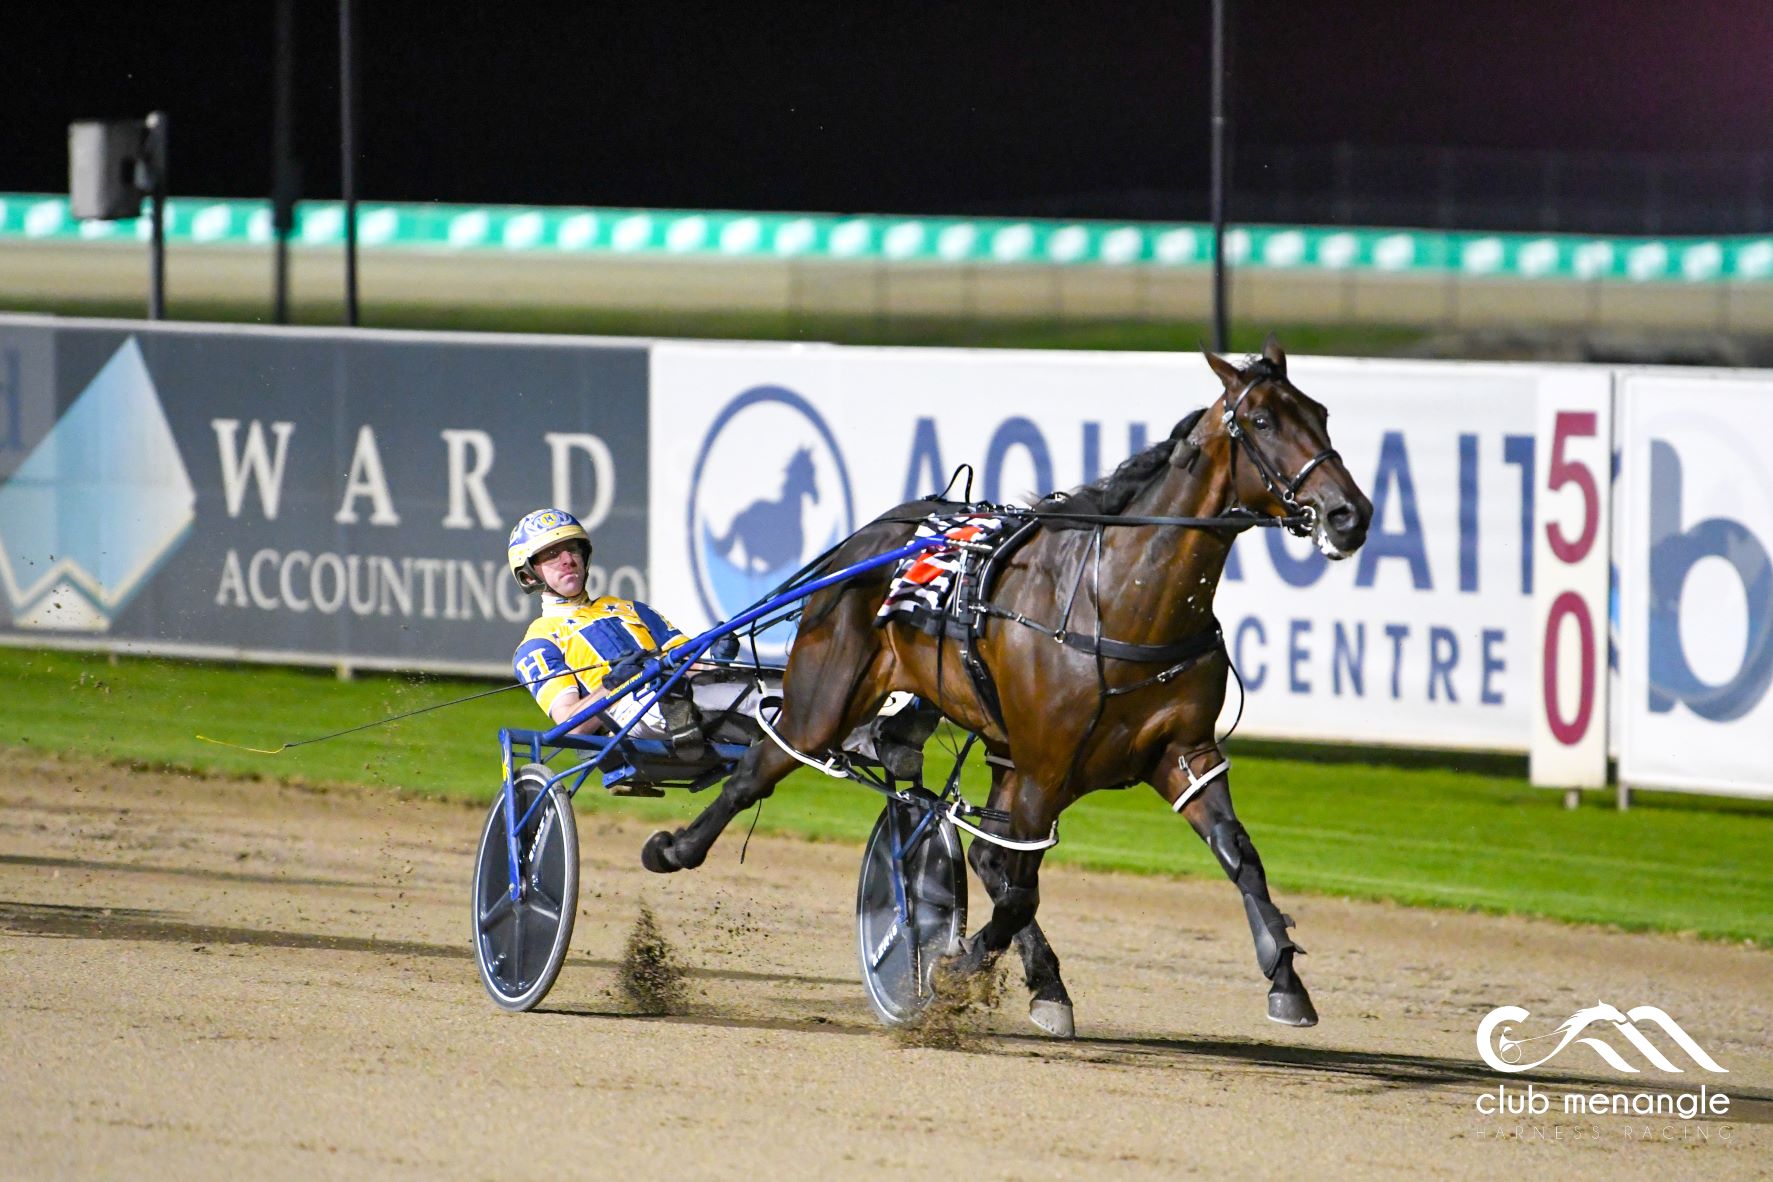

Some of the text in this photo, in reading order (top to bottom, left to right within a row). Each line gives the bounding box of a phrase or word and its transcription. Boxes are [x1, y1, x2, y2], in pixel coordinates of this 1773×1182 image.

[215, 547, 531, 623] ACCOUNTING
[1545, 411, 1599, 746] 50
[1234, 614, 1507, 705] CENTRE
